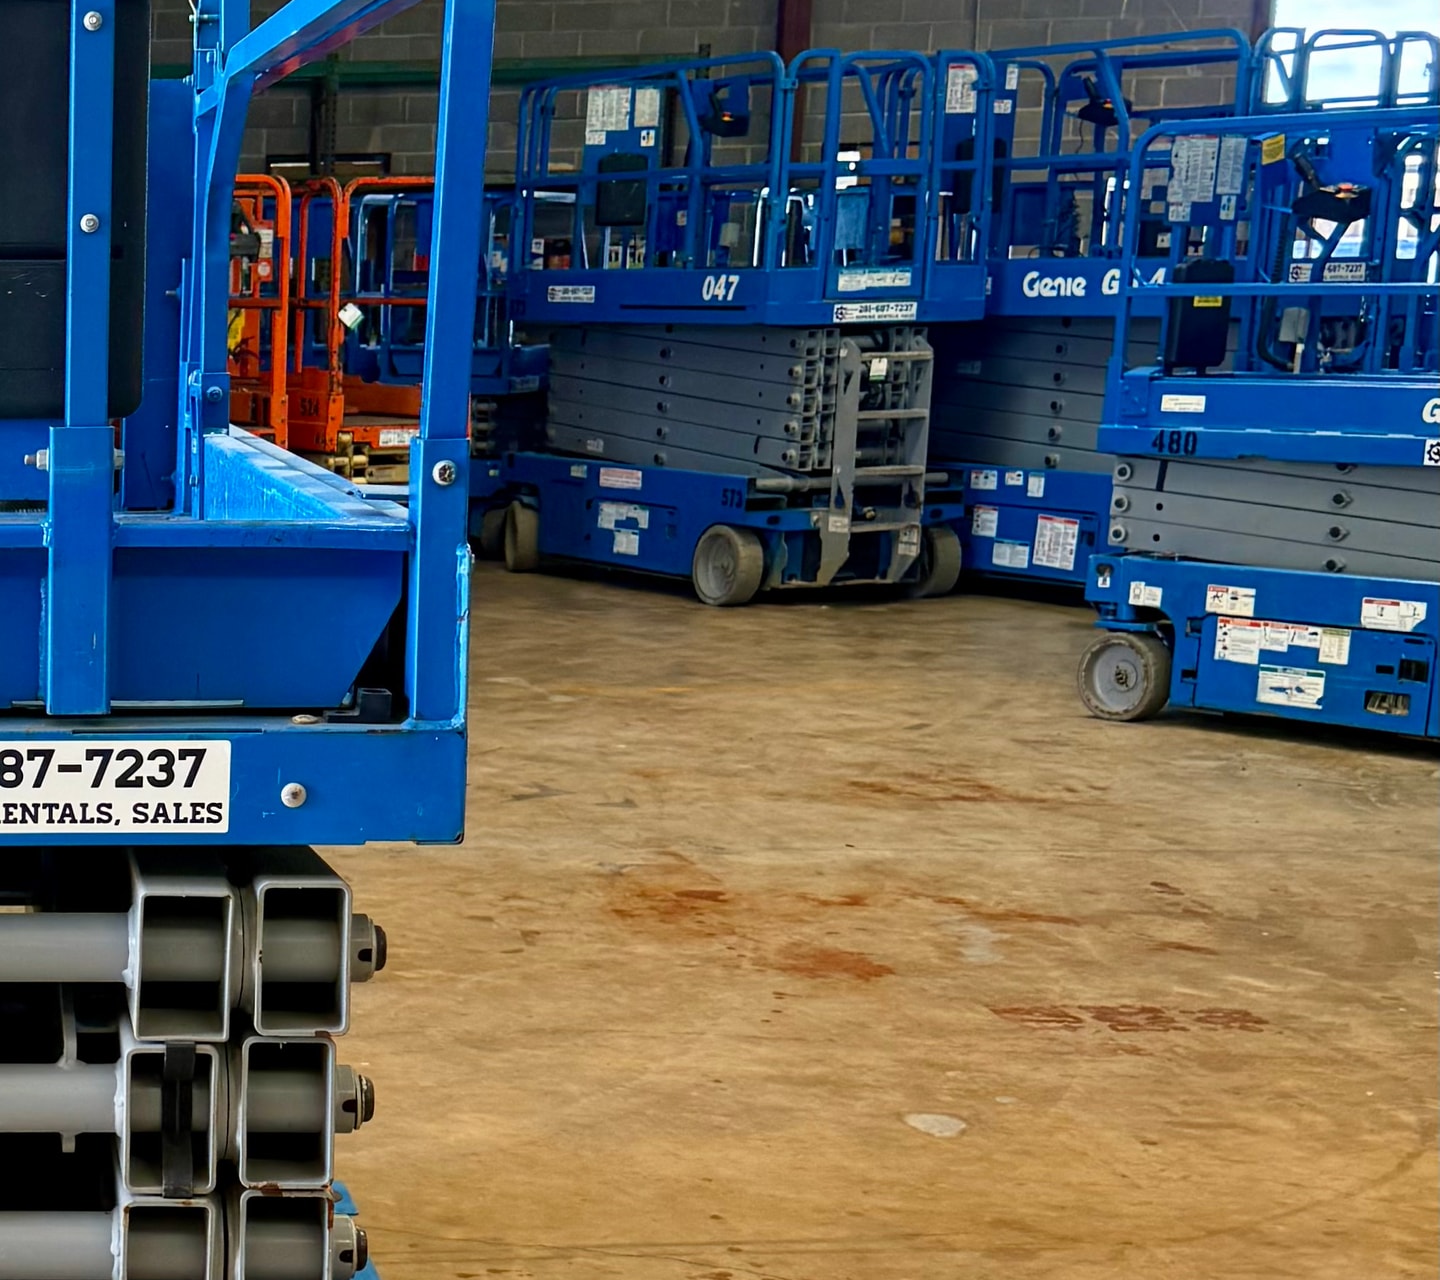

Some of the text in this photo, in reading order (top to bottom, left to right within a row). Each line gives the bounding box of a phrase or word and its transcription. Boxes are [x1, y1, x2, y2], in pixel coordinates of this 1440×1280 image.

[701, 273, 740, 302] 047
[1022, 270, 1088, 299] Genie
[1152, 429, 1198, 455] 480
[132, 802, 223, 825] SALES
